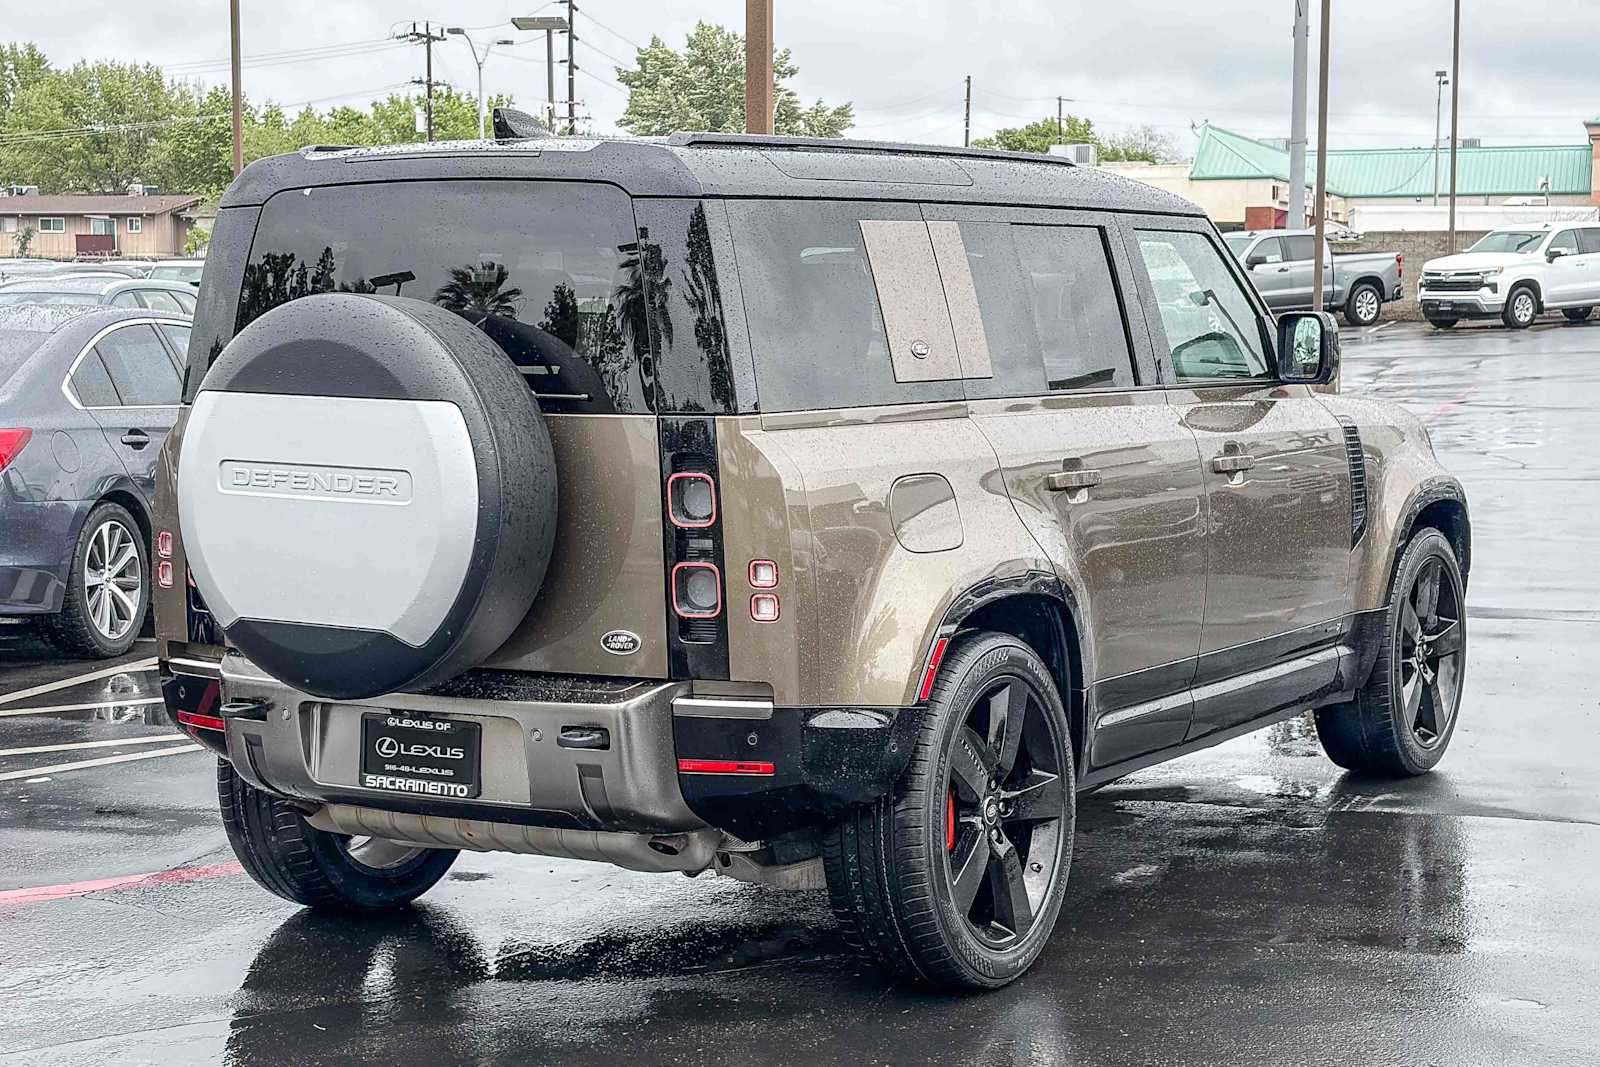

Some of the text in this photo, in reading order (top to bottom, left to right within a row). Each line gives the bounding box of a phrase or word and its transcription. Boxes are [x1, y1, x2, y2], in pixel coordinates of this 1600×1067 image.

[231, 467, 399, 495] DEFENDER
[395, 718, 451, 731] LEXUS OF
[400, 743, 465, 759] LEXUS
[384, 764, 454, 776] 916-48-LEXUS
[366, 775, 467, 797] SACRAMENTO
